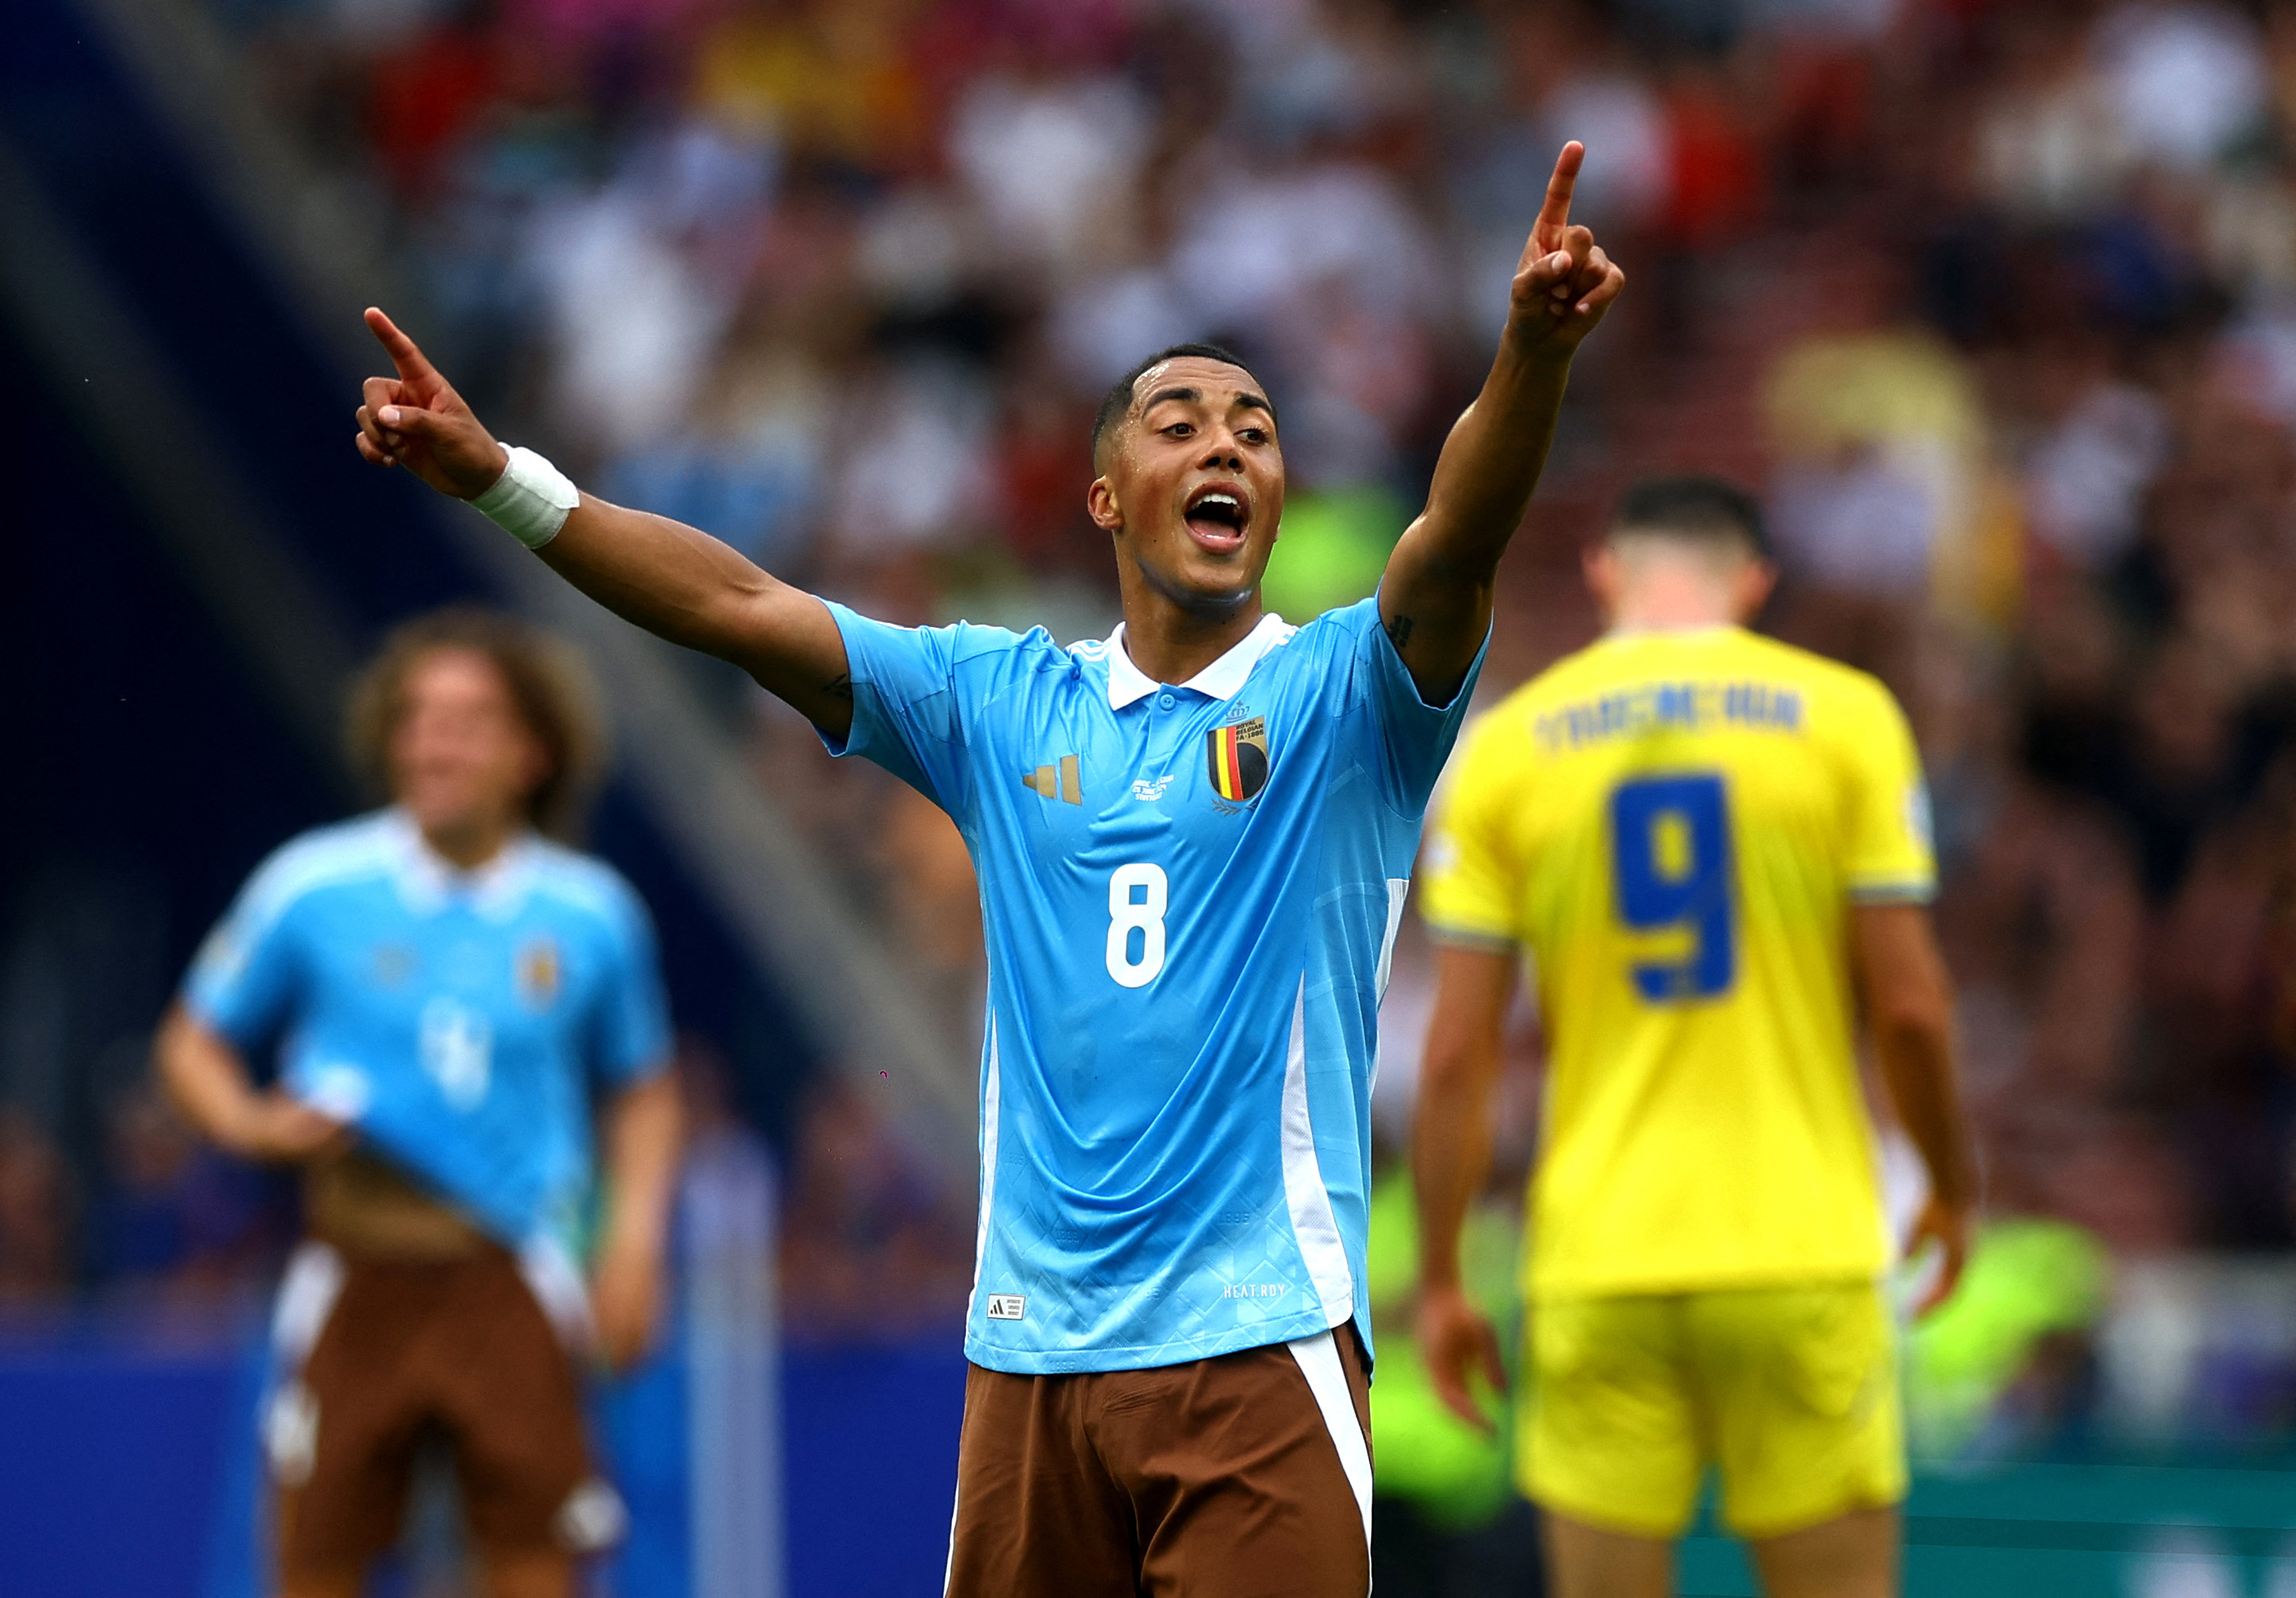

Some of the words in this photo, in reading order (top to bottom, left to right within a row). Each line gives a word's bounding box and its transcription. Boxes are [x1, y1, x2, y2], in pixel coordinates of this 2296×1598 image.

[1106, 863, 1168, 988] 8
[1610, 772, 1736, 1003] 9
[1224, 1284, 1286, 1299] HEAT.RDY
